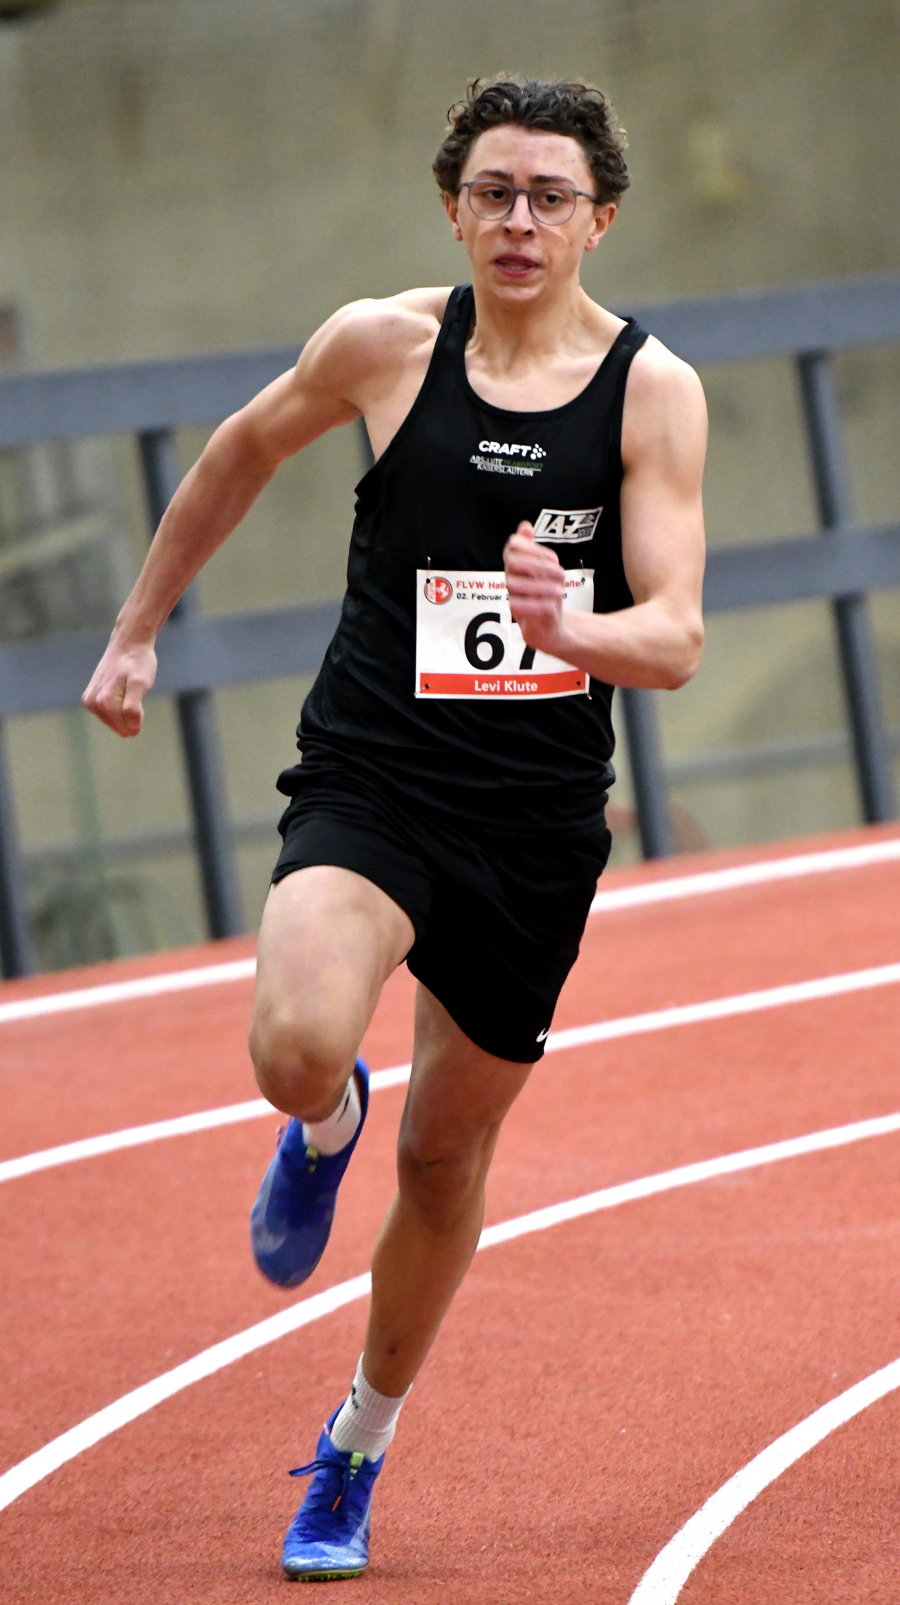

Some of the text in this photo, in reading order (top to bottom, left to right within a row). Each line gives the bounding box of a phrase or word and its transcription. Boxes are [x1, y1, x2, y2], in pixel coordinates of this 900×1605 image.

[478, 440, 532, 457] CRAFT
[534, 514, 586, 539] LAZ
[456, 581, 484, 589] FLVW
[474, 680, 538, 692] Levi Klute
